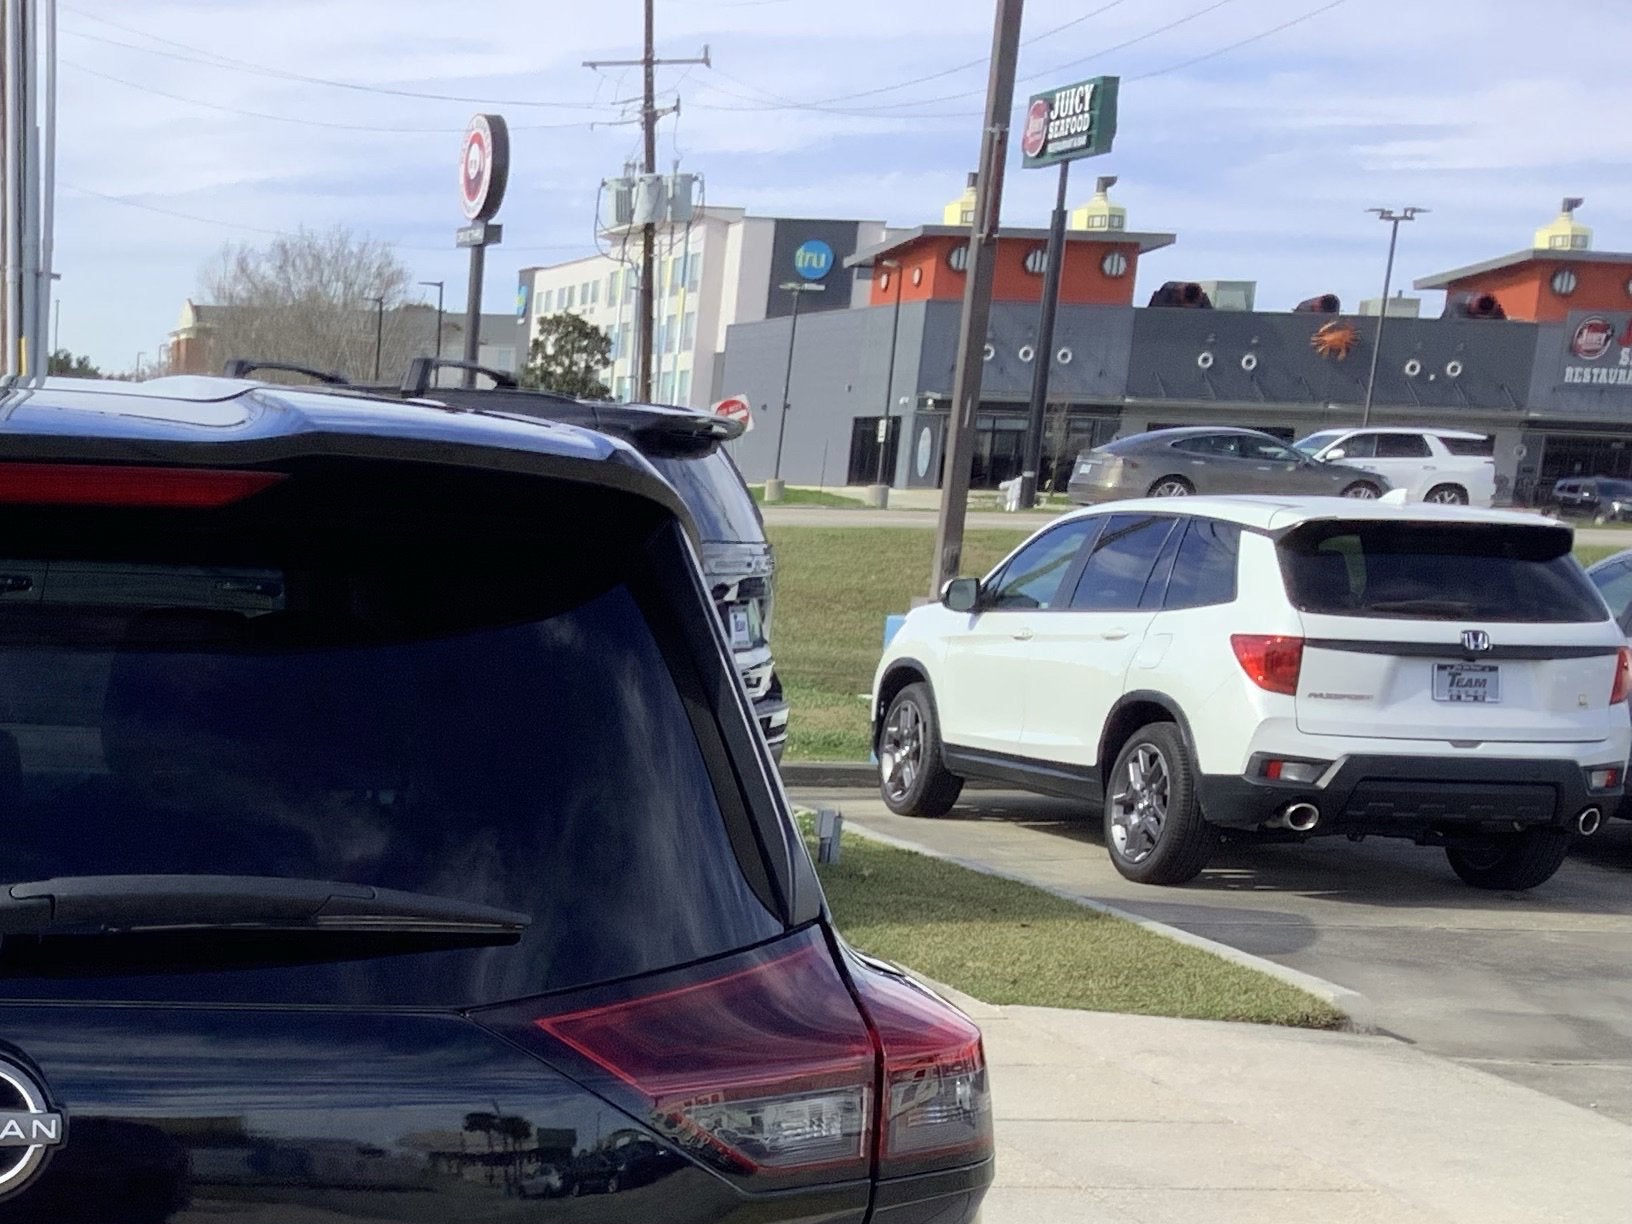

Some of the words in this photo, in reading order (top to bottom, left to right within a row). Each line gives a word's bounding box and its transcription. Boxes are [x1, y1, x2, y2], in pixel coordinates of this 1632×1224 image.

[1050, 83, 1094, 120] JUICY
[1048, 113, 1090, 139] SEAFOOD
[795, 246, 826, 269] tru
